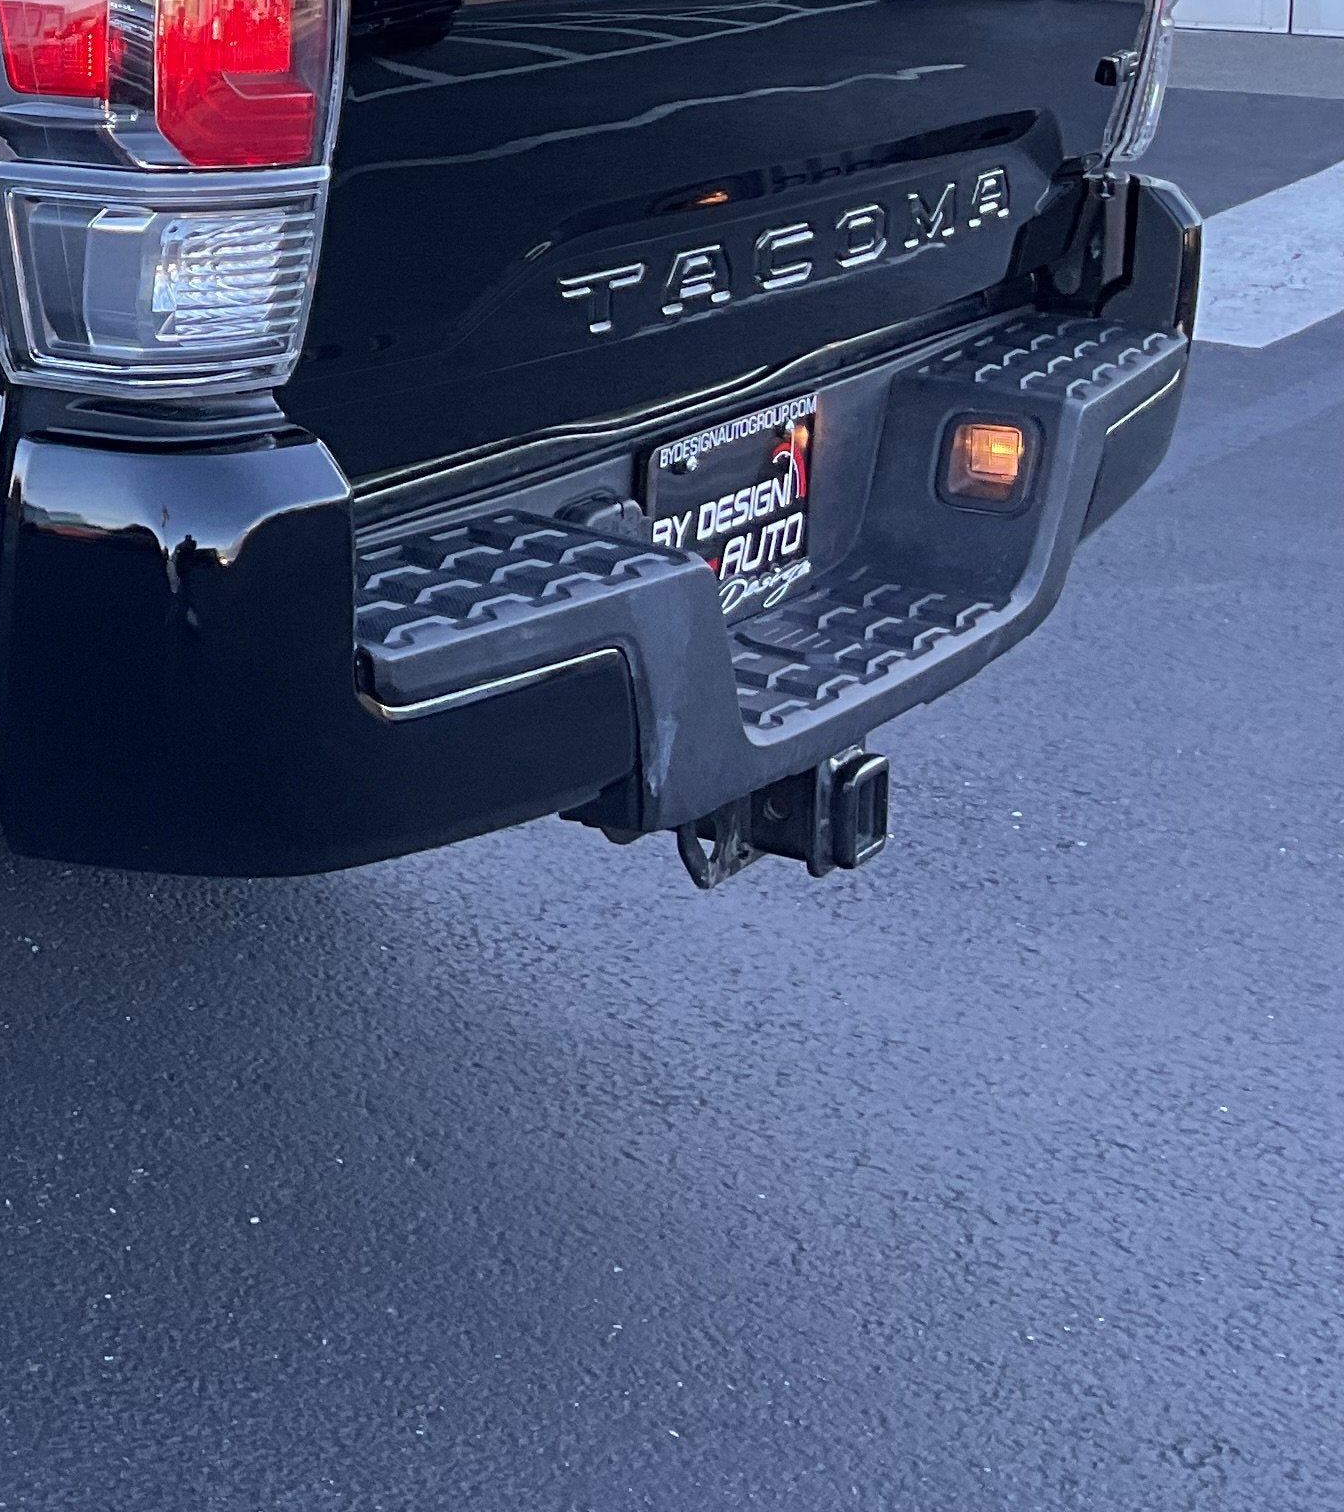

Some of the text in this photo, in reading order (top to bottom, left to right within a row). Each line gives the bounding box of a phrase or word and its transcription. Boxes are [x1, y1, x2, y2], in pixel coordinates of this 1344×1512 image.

[558, 167, 1010, 335] TACOMA
[696, 472, 794, 542] DESIGN
[718, 511, 805, 581] AUTO
